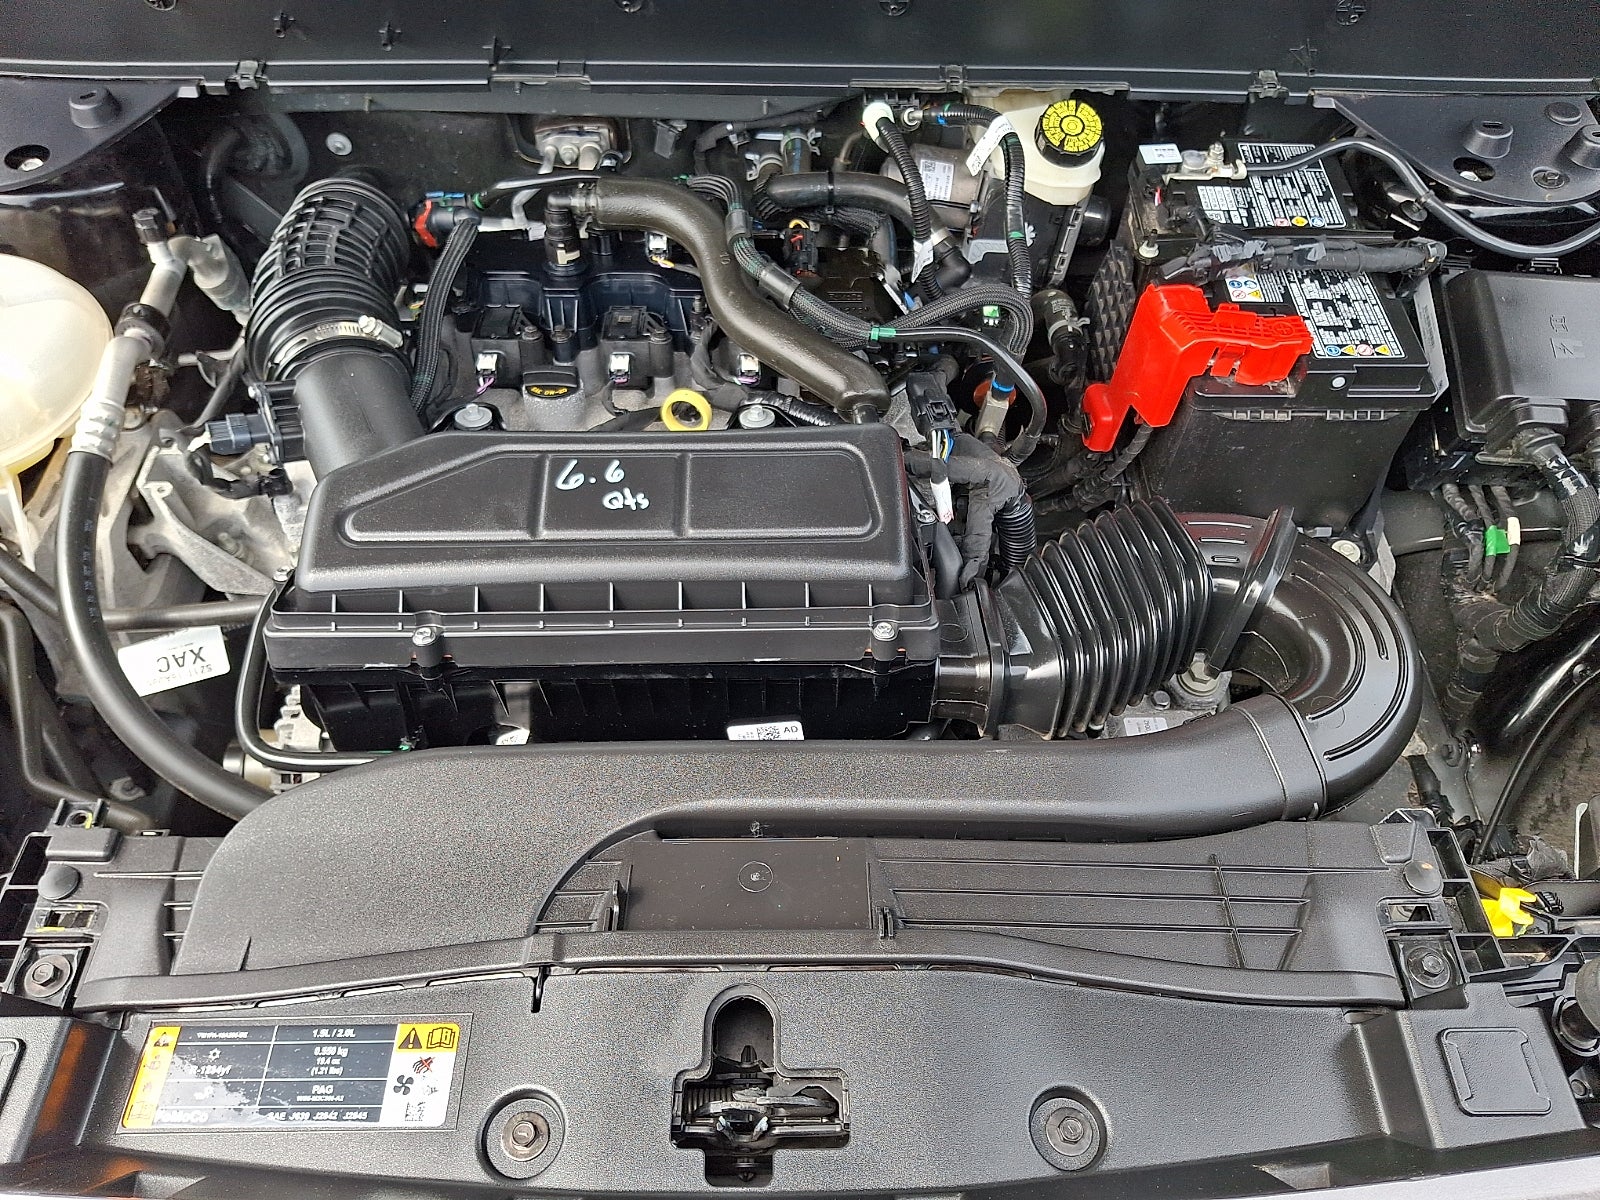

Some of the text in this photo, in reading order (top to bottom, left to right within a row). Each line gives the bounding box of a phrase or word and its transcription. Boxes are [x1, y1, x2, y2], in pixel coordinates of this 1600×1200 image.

[555, 459, 625, 491] 6.6
[602, 487, 650, 511] Qts
[156, 646, 206, 673] XAC
[784, 725, 798, 733] AD
[337, 1046, 349, 1058] kg
[311, 1085, 334, 1094] PAG
[267, 1111, 287, 1121] SAE
